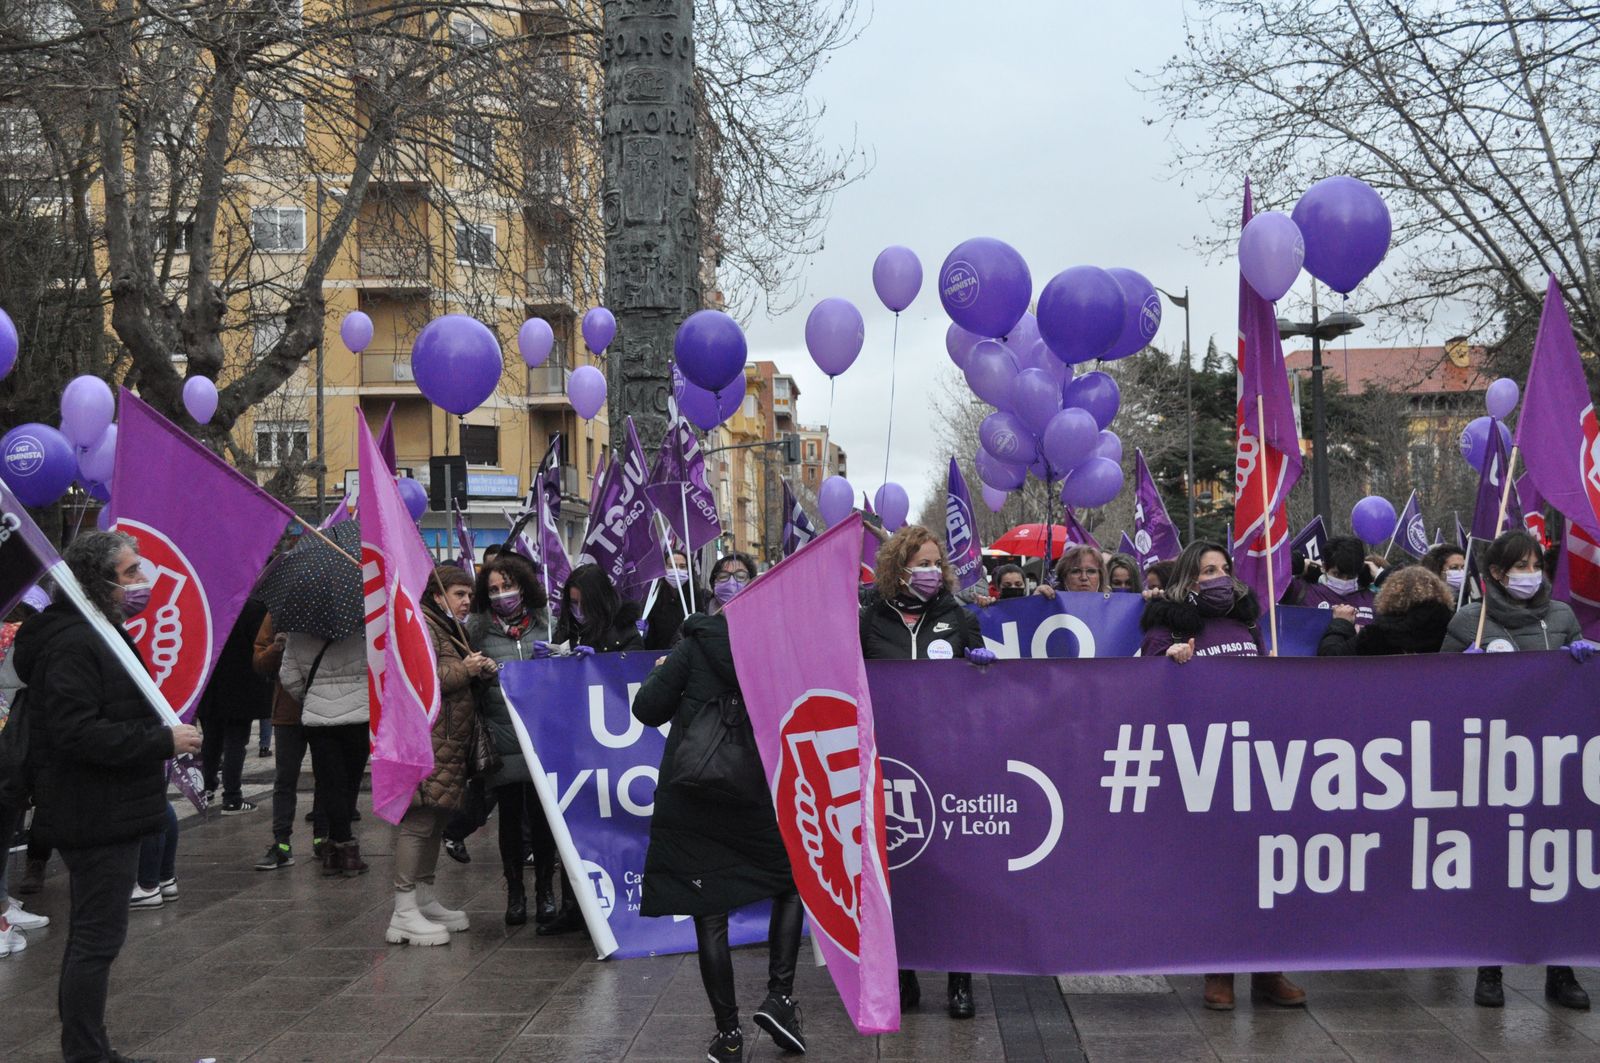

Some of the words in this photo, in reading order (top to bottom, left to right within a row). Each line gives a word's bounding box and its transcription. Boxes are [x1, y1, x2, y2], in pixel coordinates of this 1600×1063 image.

[944, 276, 977, 297] FEMINISTA
[6, 451, 42, 462] FEMINISTA
[16, 445, 29, 453] UGT
[691, 490, 719, 525] León
[1207, 645, 1221, 656] UN
[1221, 642, 1242, 653] PASO
[941, 793, 1018, 813] Castilla
[942, 820, 954, 840] y
[961, 815, 1010, 835] León
[1259, 833, 1380, 909] por
[1412, 817, 1471, 890] la
